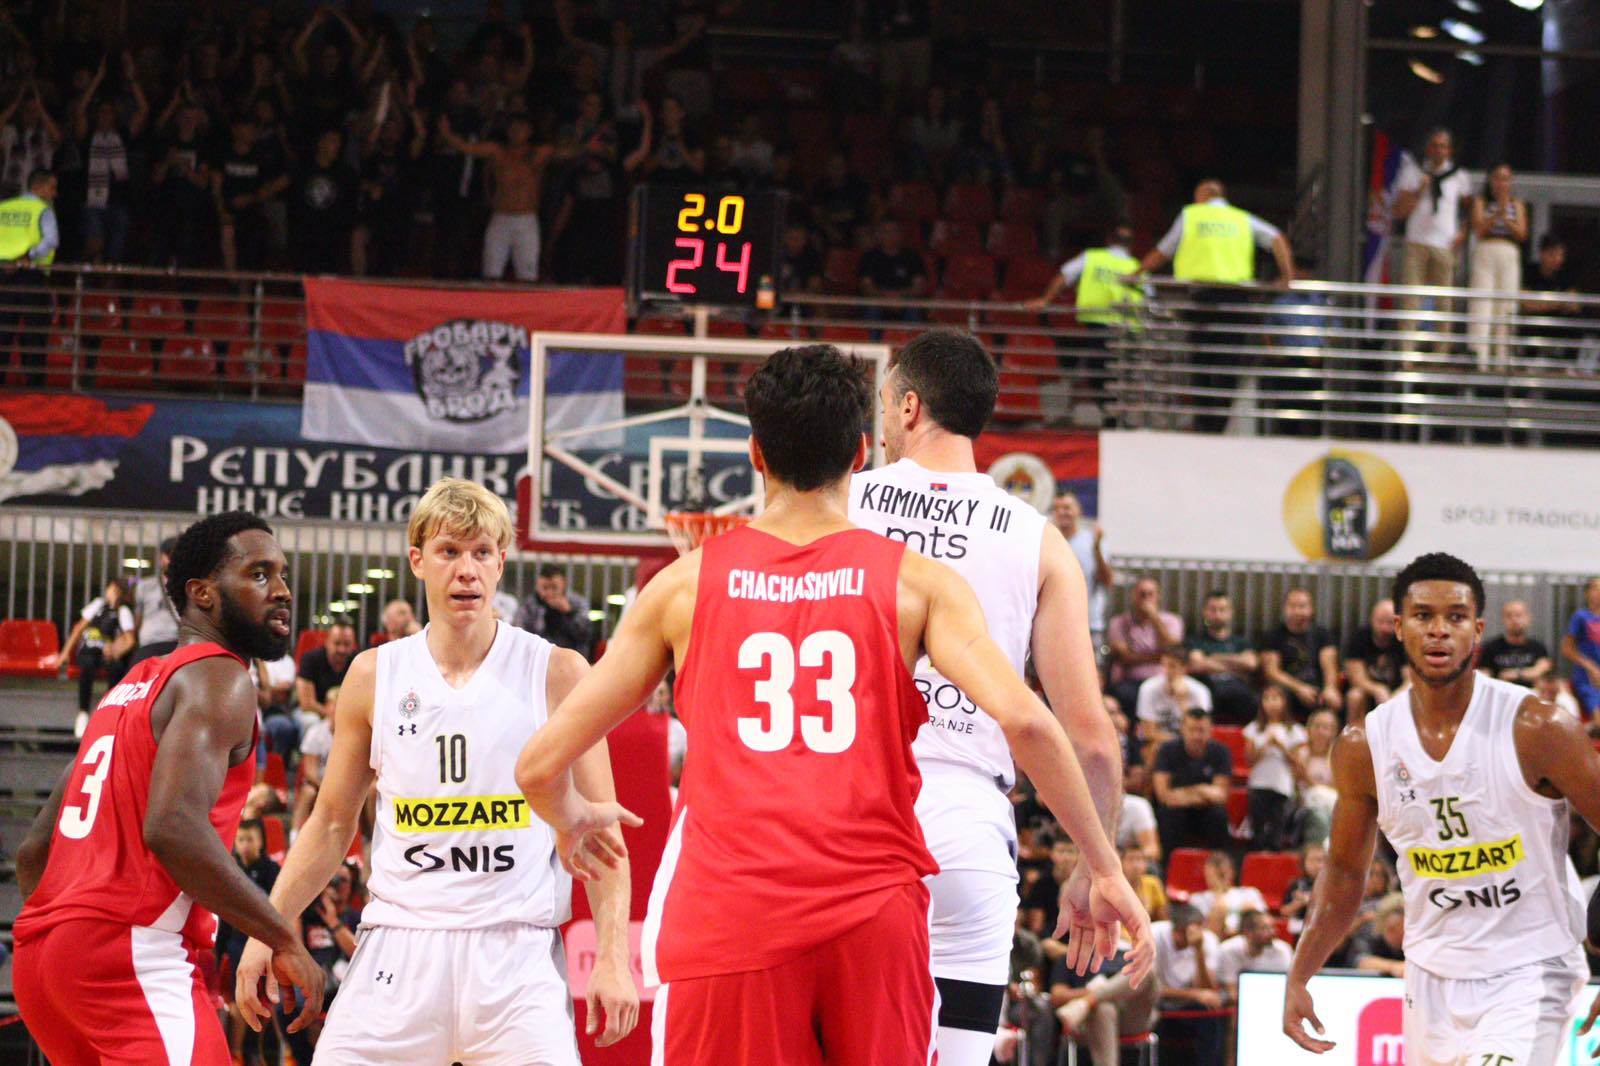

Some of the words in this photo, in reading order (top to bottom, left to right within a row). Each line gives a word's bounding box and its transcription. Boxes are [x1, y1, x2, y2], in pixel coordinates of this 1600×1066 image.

[678, 193, 745, 234] 2.0
[665, 237, 752, 293] 24
[860, 482, 980, 527] KAMINSKY
[886, 525, 969, 560] mts
[727, 567, 865, 604] CHACHASHVILI
[737, 629, 857, 754] 33
[435, 734, 468, 785] 10
[58, 734, 116, 840] 3
[396, 798, 526, 828] MOZZART
[1429, 796, 1470, 841] 35
[450, 844, 516, 874] NIS
[1412, 839, 1518, 874] MOZZART
[1464, 878, 1522, 909] NIS
